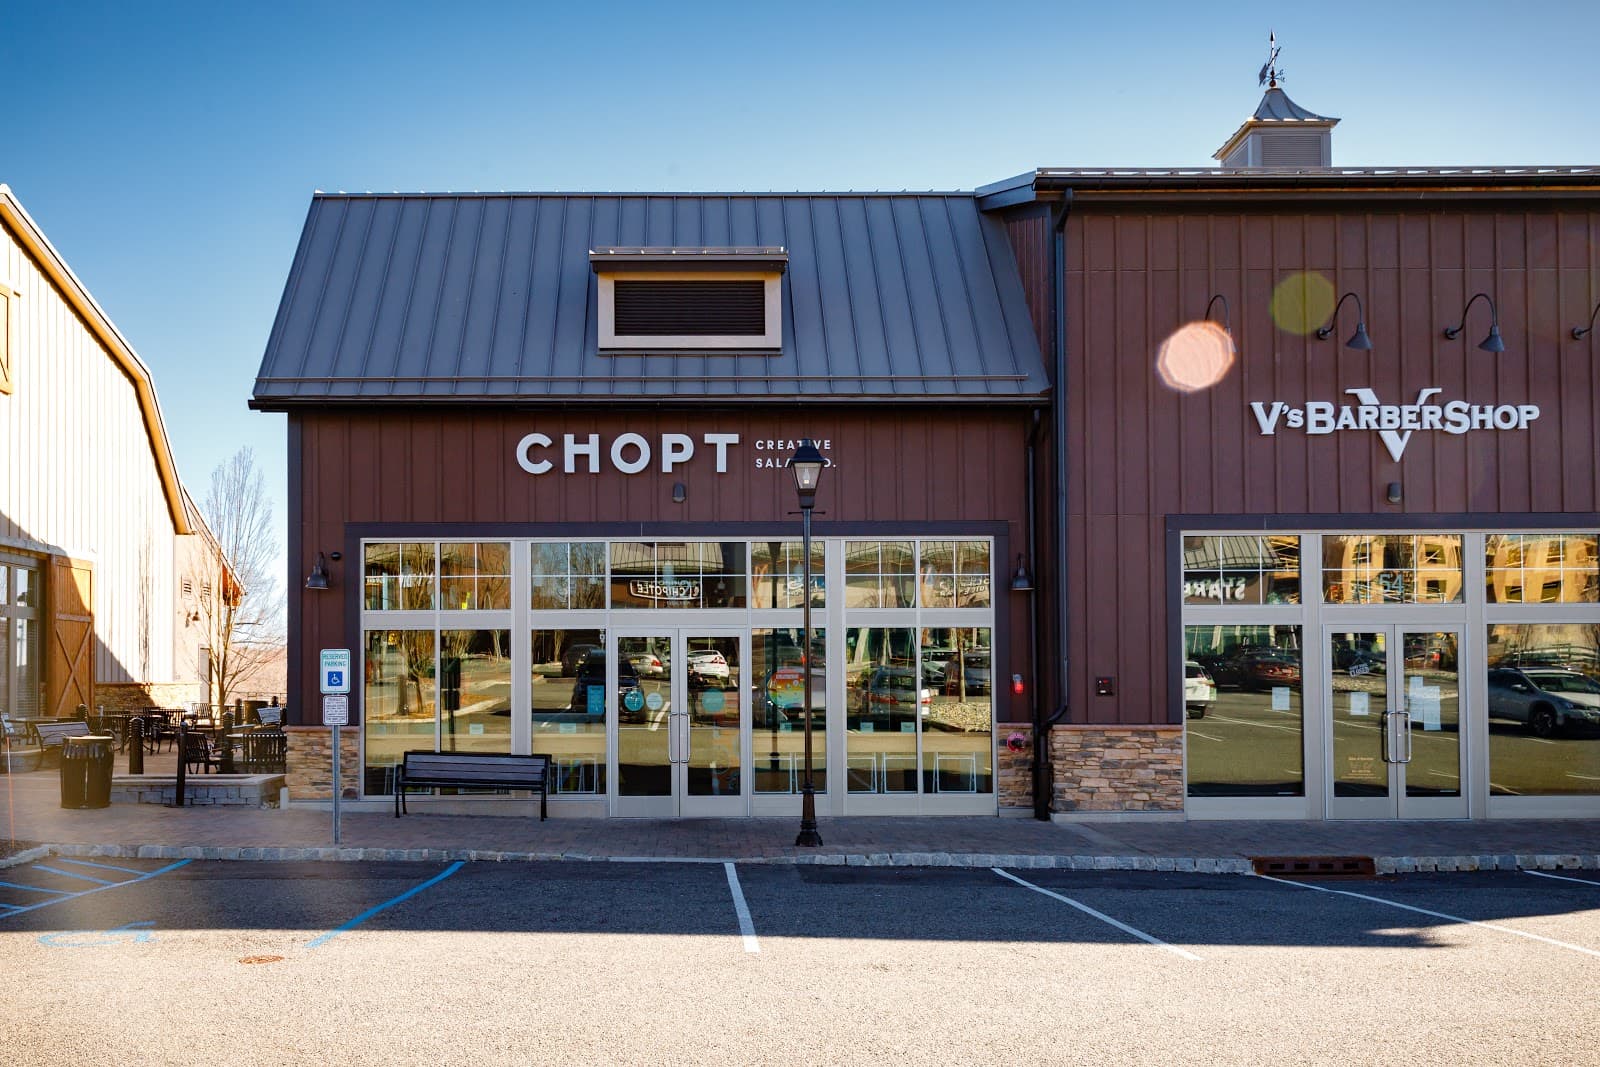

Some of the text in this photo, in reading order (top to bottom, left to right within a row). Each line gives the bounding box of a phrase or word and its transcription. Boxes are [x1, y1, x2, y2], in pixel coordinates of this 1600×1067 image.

[755, 439, 832, 450] CREATVE
[516, 432, 739, 475] CHOPT
[755, 458, 791, 468] SAL
